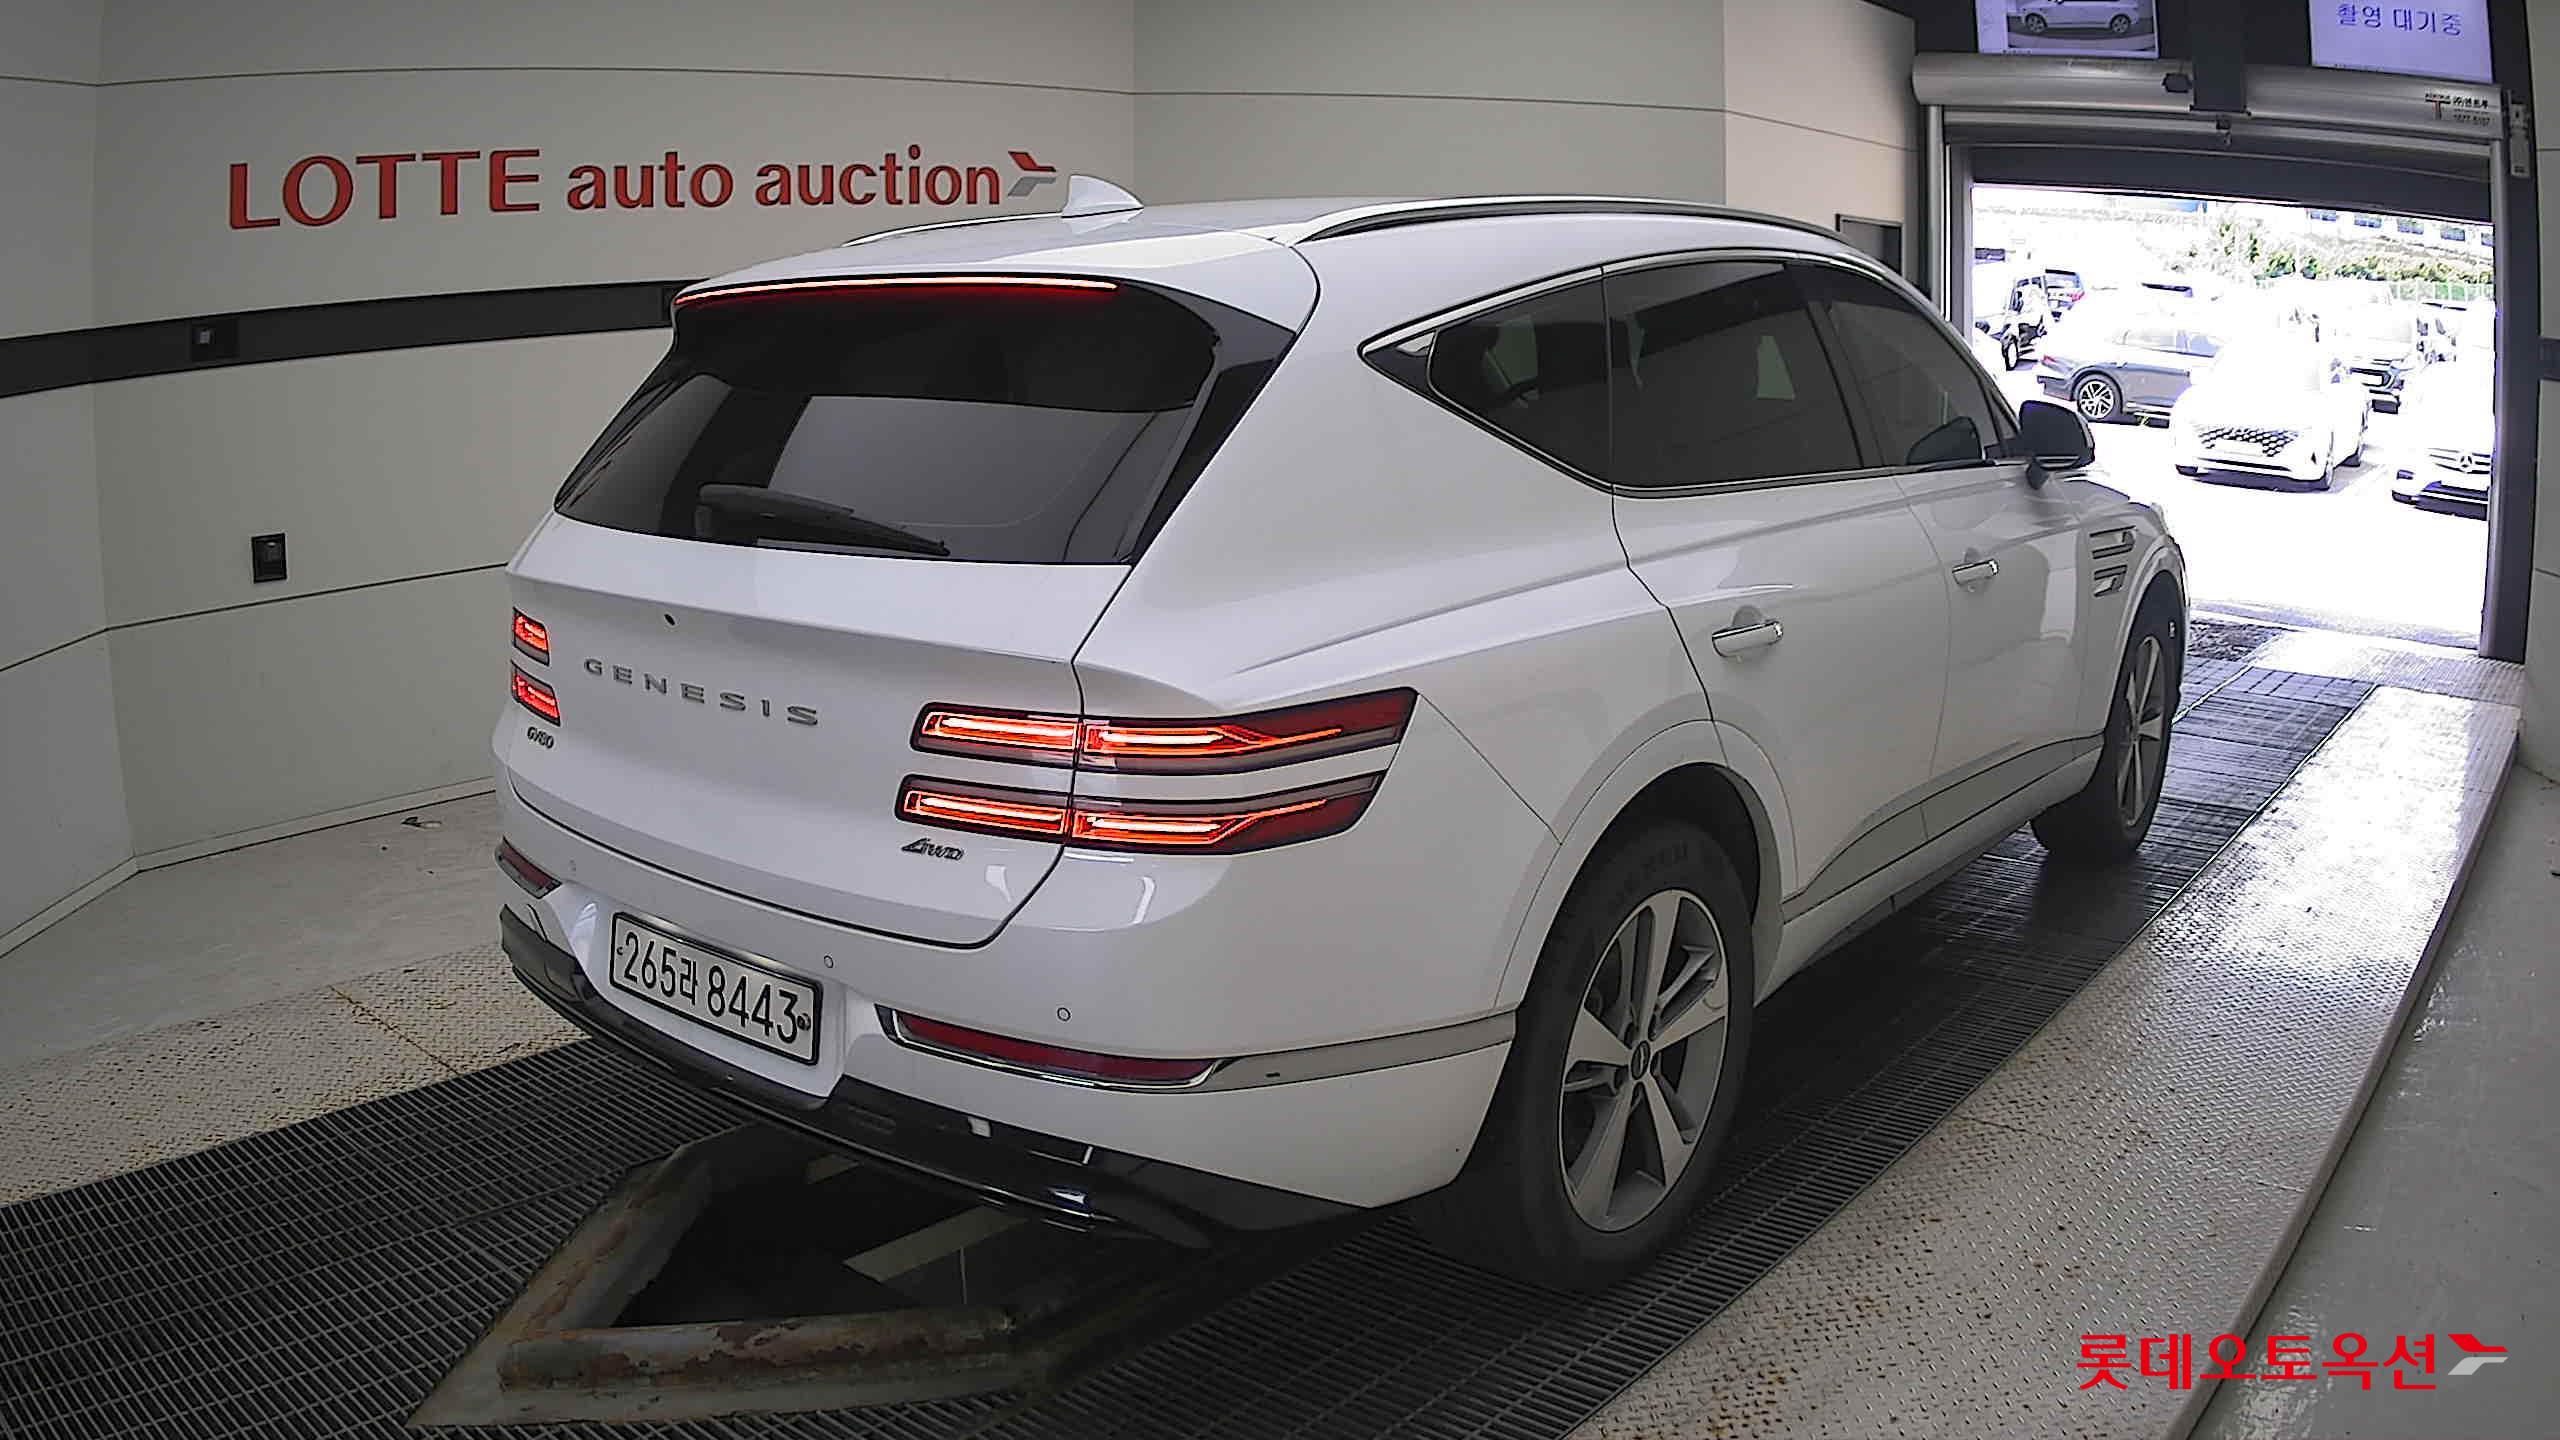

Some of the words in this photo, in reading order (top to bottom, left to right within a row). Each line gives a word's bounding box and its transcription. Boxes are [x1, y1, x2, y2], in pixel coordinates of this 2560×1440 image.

[2338, 4, 2382, 29] 촬영
[2393, 8, 2462, 36] 대기중
[229, 149, 541, 230] LOTTE
[567, 150, 733, 209] auto
[755, 145, 1002, 206] auction
[584, 658, 818, 727] GENESIS
[527, 726, 555, 749] GV80
[624, 931, 698, 1006] 265라
[707, 965, 799, 1044] 8443
